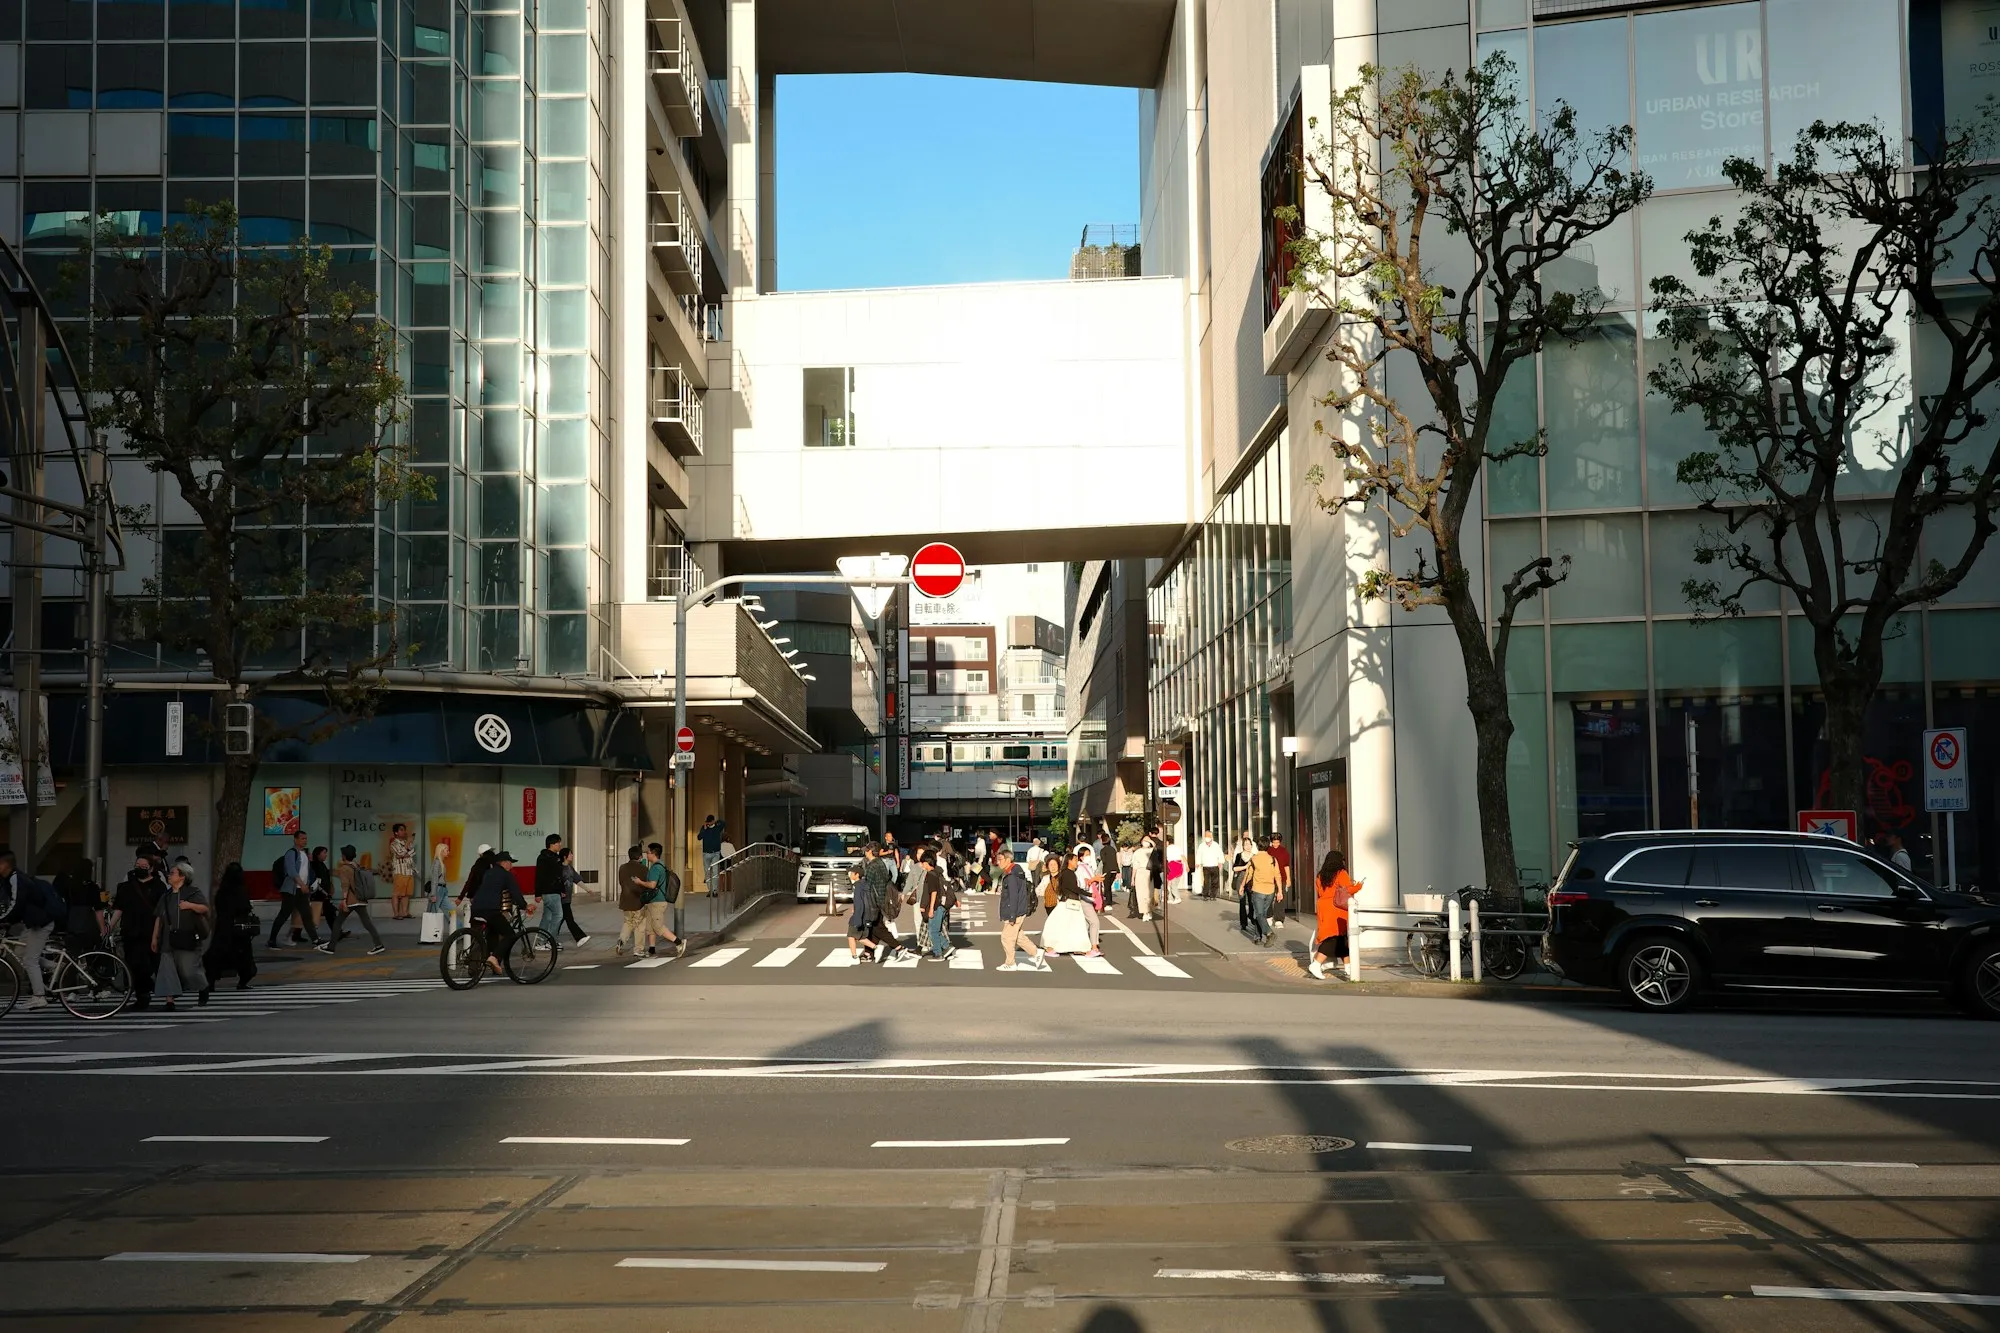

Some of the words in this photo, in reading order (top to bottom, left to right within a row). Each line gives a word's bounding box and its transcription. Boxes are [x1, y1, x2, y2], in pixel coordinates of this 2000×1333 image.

[1646, 95, 1710, 114] URBAN
[1716, 81, 1820, 108] RESEARCH
[1700, 107, 1764, 130] Store
[1672, 146, 1739, 161] RESEARCH
[914, 602, 961, 615] 自転車を除く
[342, 769, 387, 788] Daily
[343, 795, 372, 809] Tea
[342, 818, 386, 832] Place
